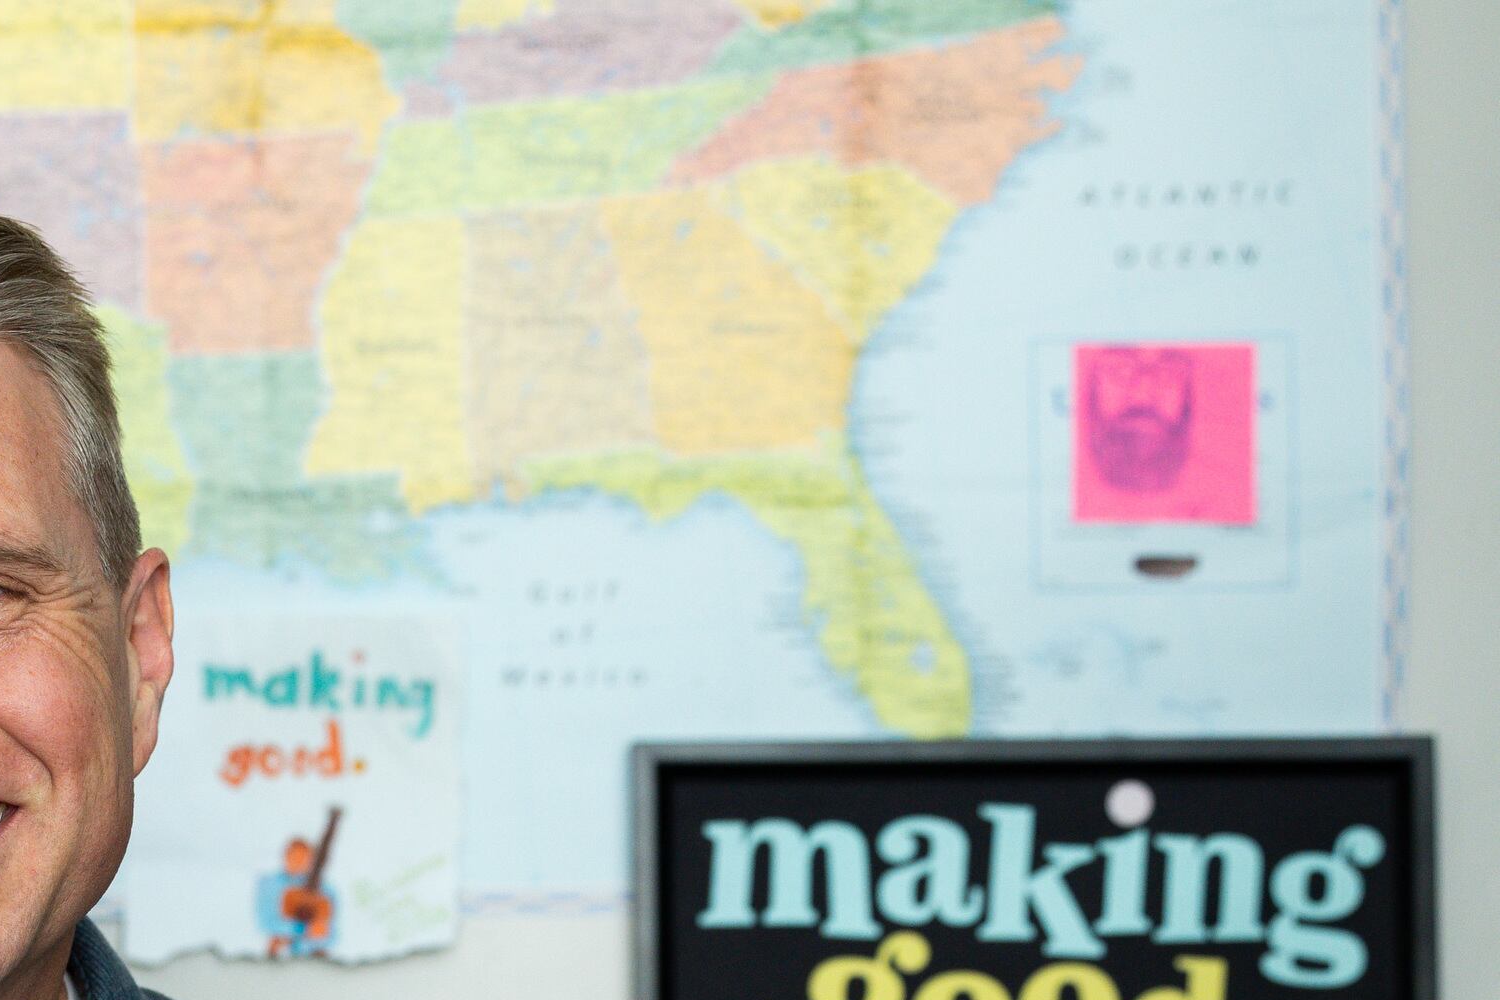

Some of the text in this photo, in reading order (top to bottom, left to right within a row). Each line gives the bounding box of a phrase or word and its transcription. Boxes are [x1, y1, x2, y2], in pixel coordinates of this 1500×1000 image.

[1077, 179, 1294, 207] ATLANTIC
[1113, 243, 1260, 269] OCEAN
[526, 578, 621, 606] Gulf
[202, 649, 436, 739] making
[698, 779, 1386, 988] making
